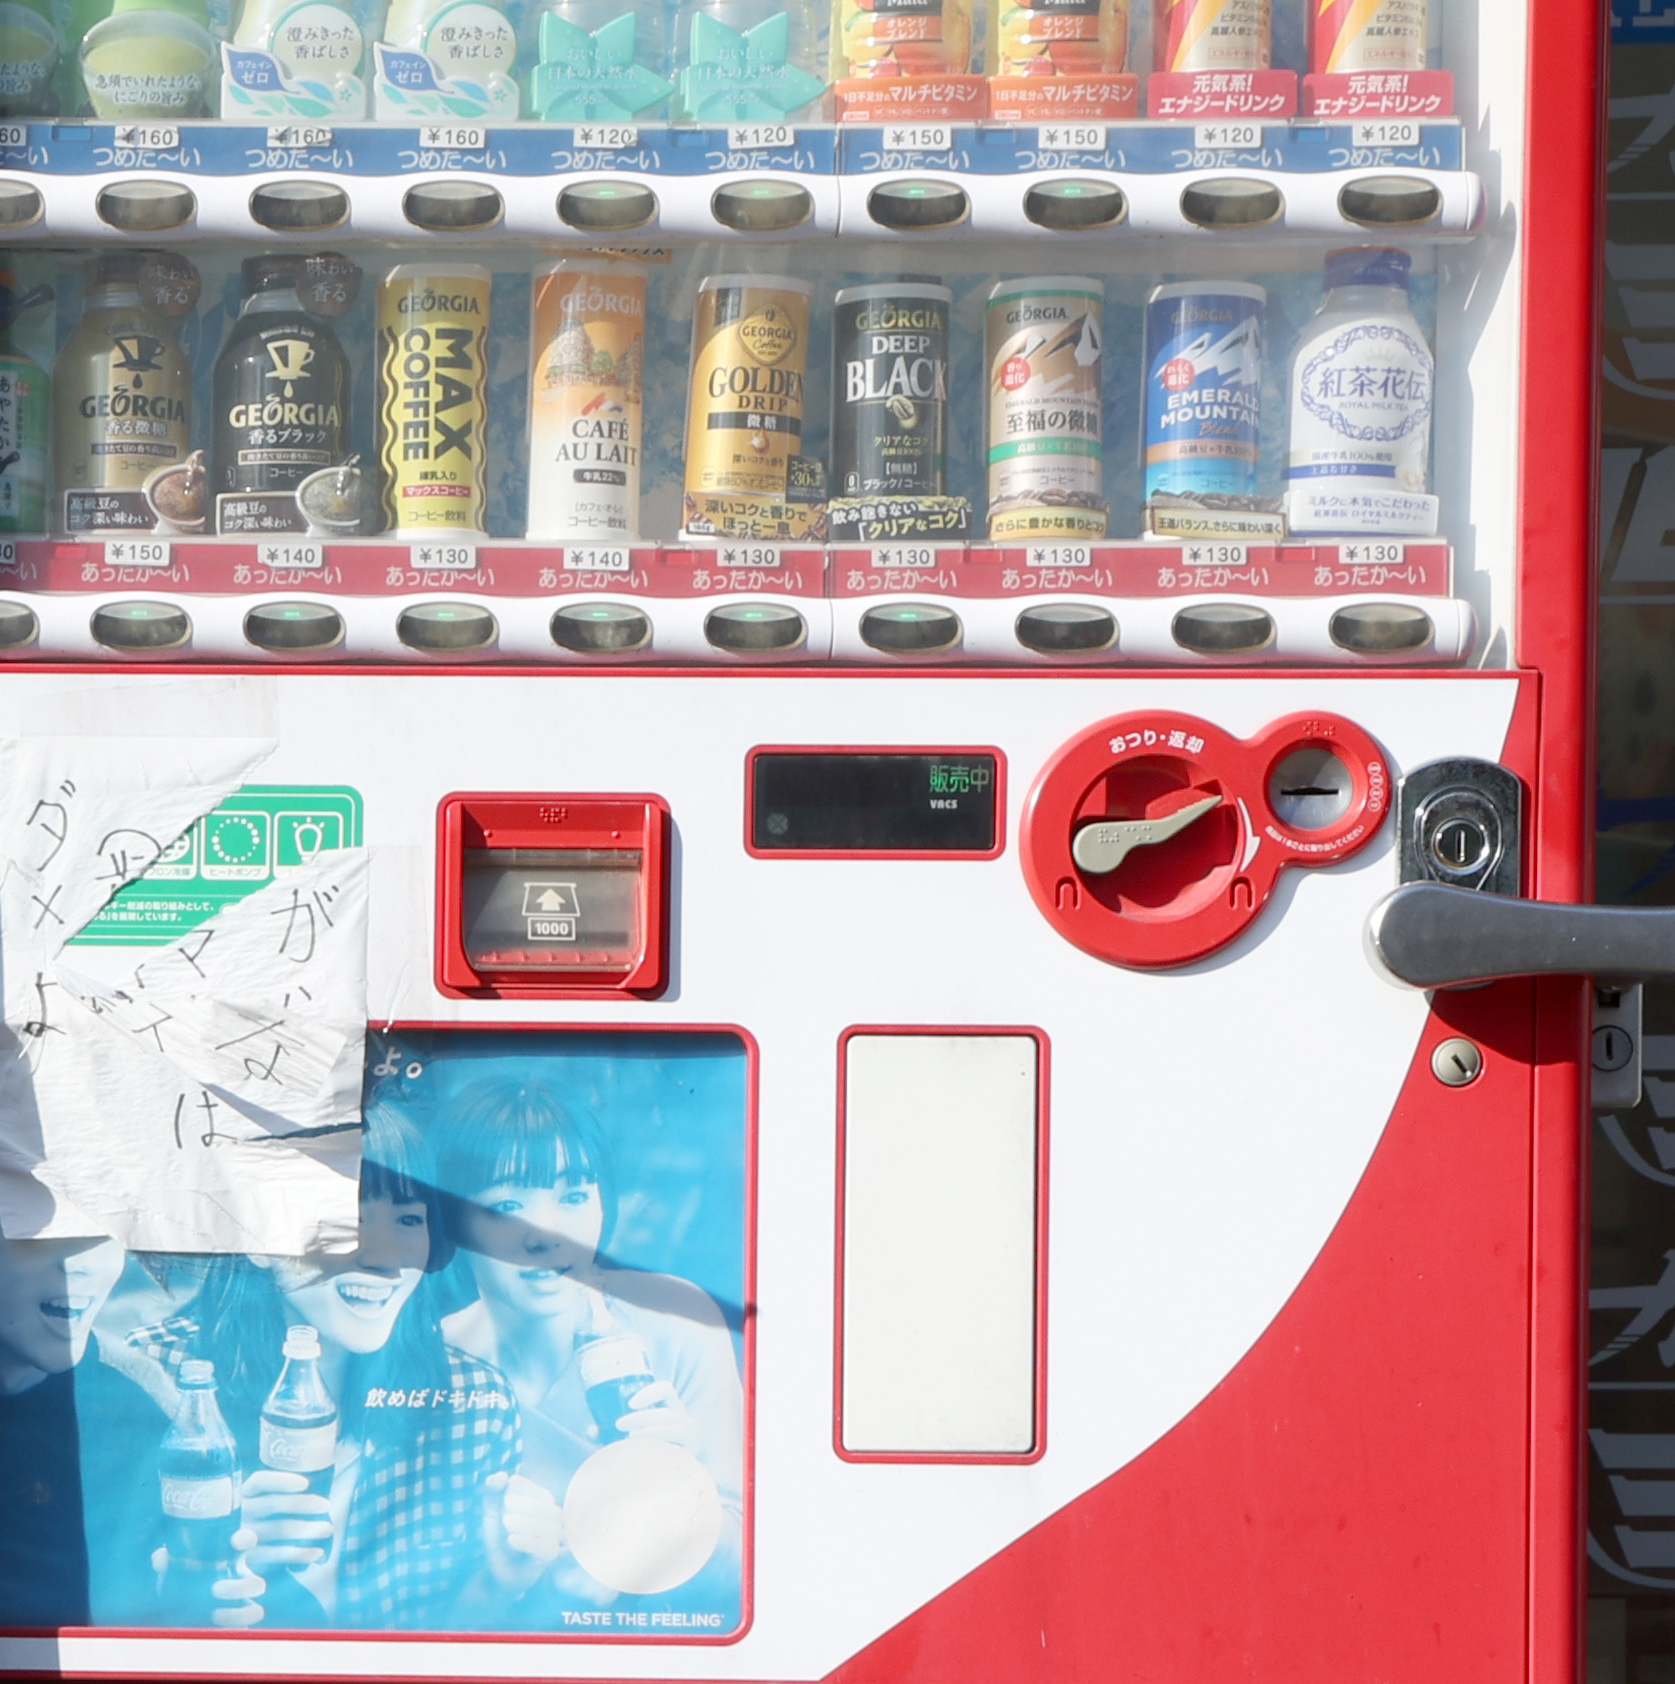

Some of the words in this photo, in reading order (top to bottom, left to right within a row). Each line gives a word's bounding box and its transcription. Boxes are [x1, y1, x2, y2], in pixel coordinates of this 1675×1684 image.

[287, 26, 355, 42] 澄みきった
[440, 26, 509, 42] 澄みきった
[294, 45, 350, 60] 香ばしさ
[448, 44, 505, 59] 香ばしさ
[236, 60, 273, 70] カフェイン
[390, 60, 427, 70] カフェイン
[241, 71, 269, 84] ゼロ
[395, 71, 423, 84] ゼロ
[1192, 74, 1253, 94] 元気系!
[1348, 75, 1409, 94] 元気系!
[114, 90, 186, 105] にごりの旨み
[1158, 94, 1286, 114] エナジードリンク
[1313, 95, 1442, 115] エナジードリンク
[427, 130, 480, 146] ¥160
[580, 127, 631, 145] ¥120
[735, 126, 787, 145] ¥120
[892, 129, 945, 146] ¥150
[1045, 129, 1099, 146] ¥150
[1203, 127, 1254, 143] ¥120
[1360, 125, 1412, 142] ¥120
[311, 283, 348, 302] 香る
[397, 288, 481, 315] GEORGIA
[560, 287, 641, 316] GEORGIA
[855, 302, 941, 331] GEORGIA
[1006, 303, 1068, 322] GEORGIA
[1170, 305, 1233, 324] GEORGIA
[741, 327, 794, 341] GEORGIA
[872, 335, 931, 355] DEEP
[845, 355, 947, 402] BLACK
[1316, 365, 1427, 402] 紅茶花伝
[403, 327, 432, 461] COFFEE
[434, 327, 474, 461] MAX
[1166, 387, 1260, 412] EMERALD
[79, 384, 185, 422] GEORGIA
[229, 393, 340, 429] GEORGIA
[738, 395, 790, 413] DRIP
[572, 416, 629, 442] CAFÉ
[1006, 410, 1098, 434] 至福の微糖
[249, 428, 327, 446] 香るブラック
[555, 443, 589, 463] AU
[593, 443, 638, 466] LAIT
[270, 467, 305, 478] コーヒー
[419, 470, 457, 482] 練乳入り
[1039, 474, 1075, 485] コーヒー
[405, 485, 471, 498] マックスコーヒー
[223, 501, 267, 518] 高級豆の
[408, 509, 467, 523] コーヒー飲料
[705, 499, 808, 523] 深いコクと香りで
[832, 501, 916, 526] 飲み飽きない
[71, 512, 149, 526] コク深い味わい
[223, 515, 292, 532] コク深い味わい
[568, 516, 627, 530] コーヒー飲料
[723, 516, 790, 535] ほっと一息
[857, 507, 968, 541] 「クリアなコク」
[995, 517, 1106, 533] さらに豊かな香りとコク
[111, 543, 162, 560] ¥150
[266, 547, 315, 564] ¥140
[419, 547, 468, 565] ¥130
[571, 550, 623, 567] ¥140
[723, 549, 775, 565] ¥130
[878, 549, 931, 565] ¥130
[1033, 548, 1086, 564] ¥130
[1188, 546, 1242, 564] ¥130
[1345, 545, 1399, 562] ¥130
[1109, 729, 1206, 755] おつり・返却
[929, 765, 990, 794] 販売中
[209, 866, 262, 877] ヒートポンプ
[94, 911, 183, 922] る」を展開しています。
[534, 922, 570, 936] 1000
[364, 1387, 512, 1410] 飲めばドキドキ。
[562, 1611, 613, 1627] TASTE
[616, 1611, 648, 1627] THE
[651, 1612, 722, 1628] FEELING
